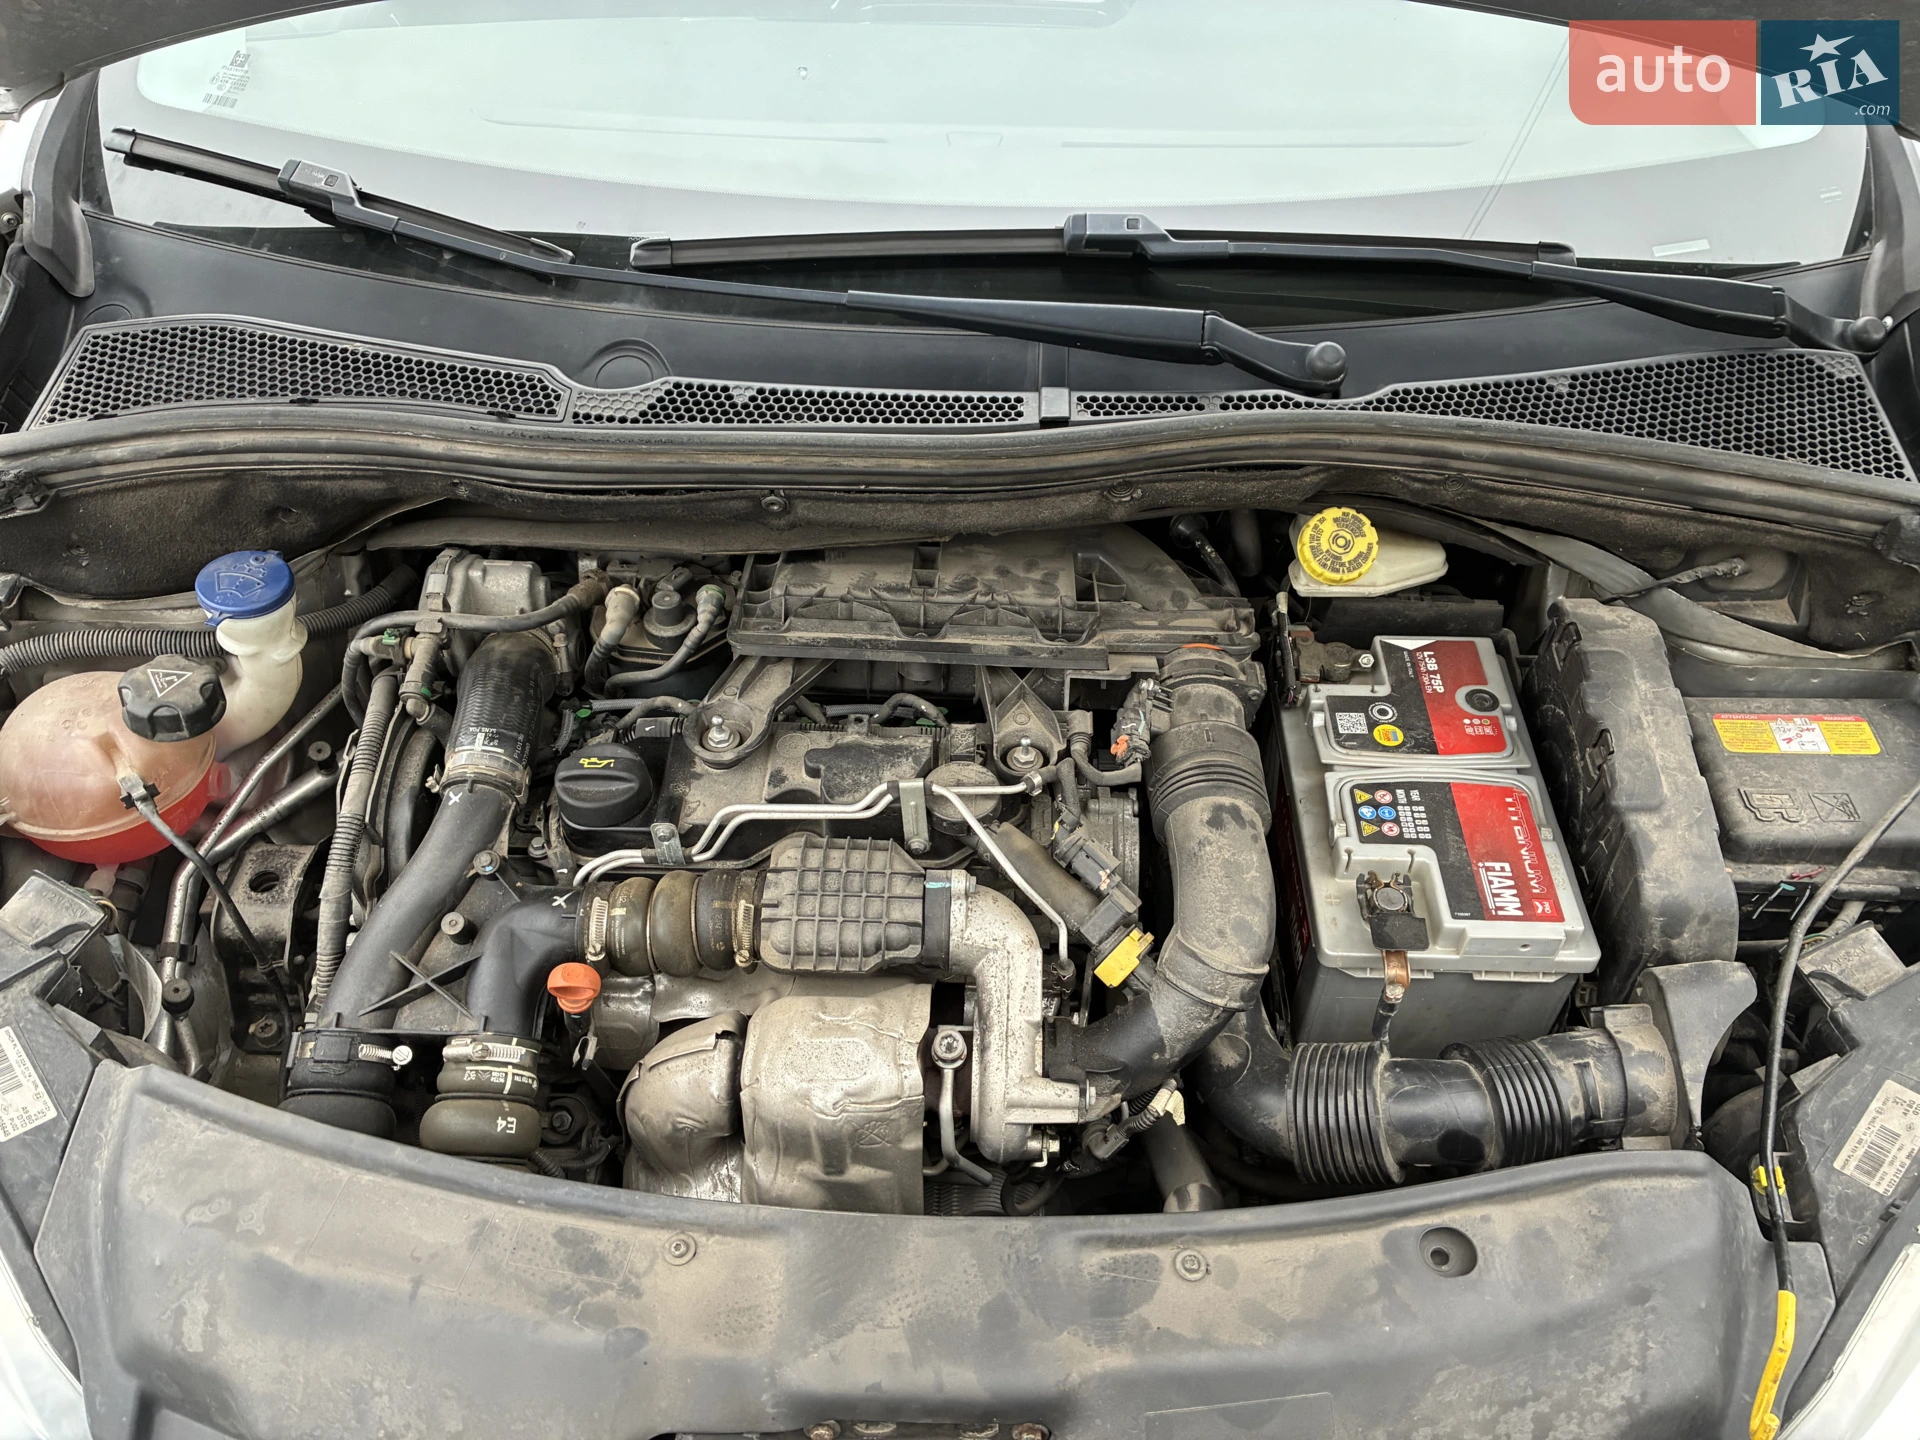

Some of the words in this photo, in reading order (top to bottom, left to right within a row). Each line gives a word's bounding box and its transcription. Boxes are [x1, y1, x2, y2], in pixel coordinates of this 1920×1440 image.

[1418, 660, 1427, 673] 75Ah
[1423, 651, 1439, 671] L3B
[1421, 672, 1430, 686] 730A
[1429, 673, 1445, 694] 75P
[1425, 684, 1433, 694] EN
[1409, 788, 1420, 802] YEAR
[1484, 862, 1524, 916] FIAMM
[1542, 901, 1552, 914] PRO
[496, 1116, 516, 1133] E4
